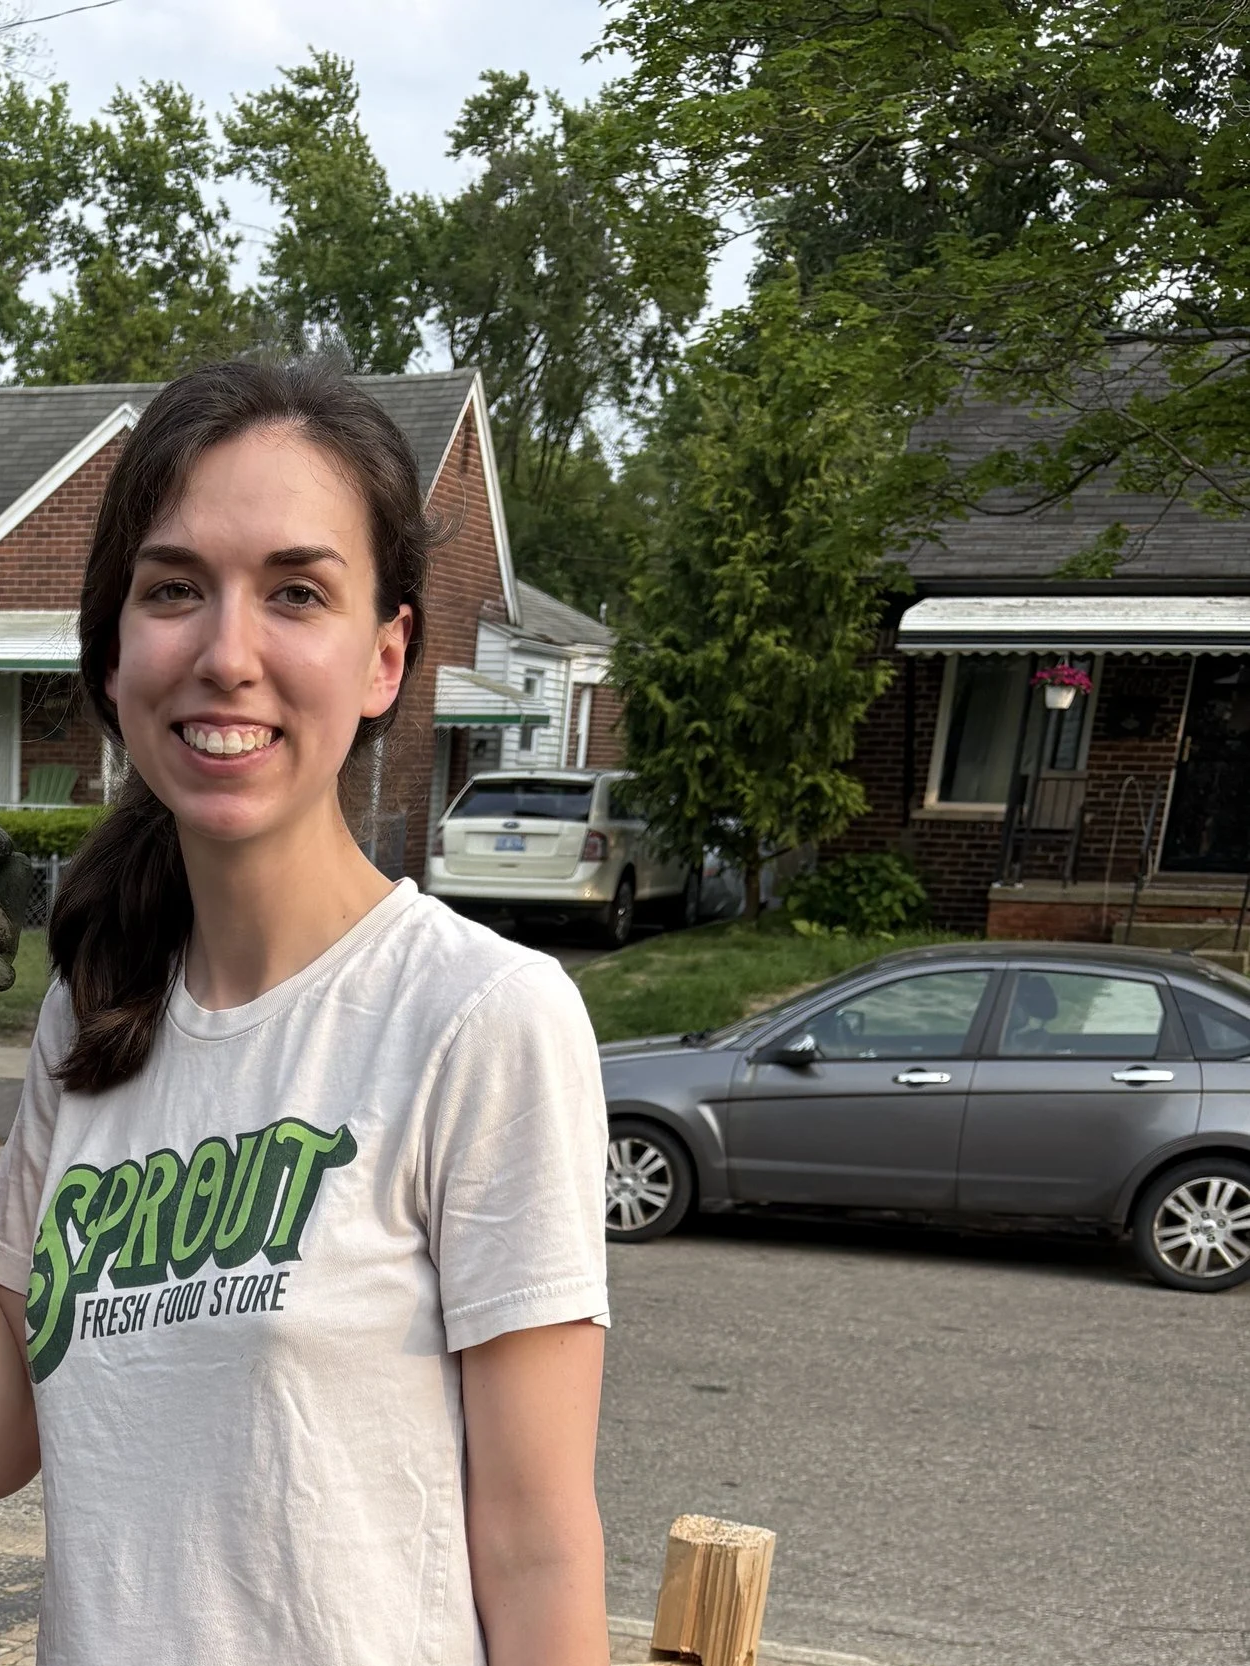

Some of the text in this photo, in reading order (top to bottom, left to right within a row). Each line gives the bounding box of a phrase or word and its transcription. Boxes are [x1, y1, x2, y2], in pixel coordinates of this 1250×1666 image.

[26, 1117, 357, 1384] SPROUT
[80, 1271, 290, 1340] FRESH FOOD STORE
